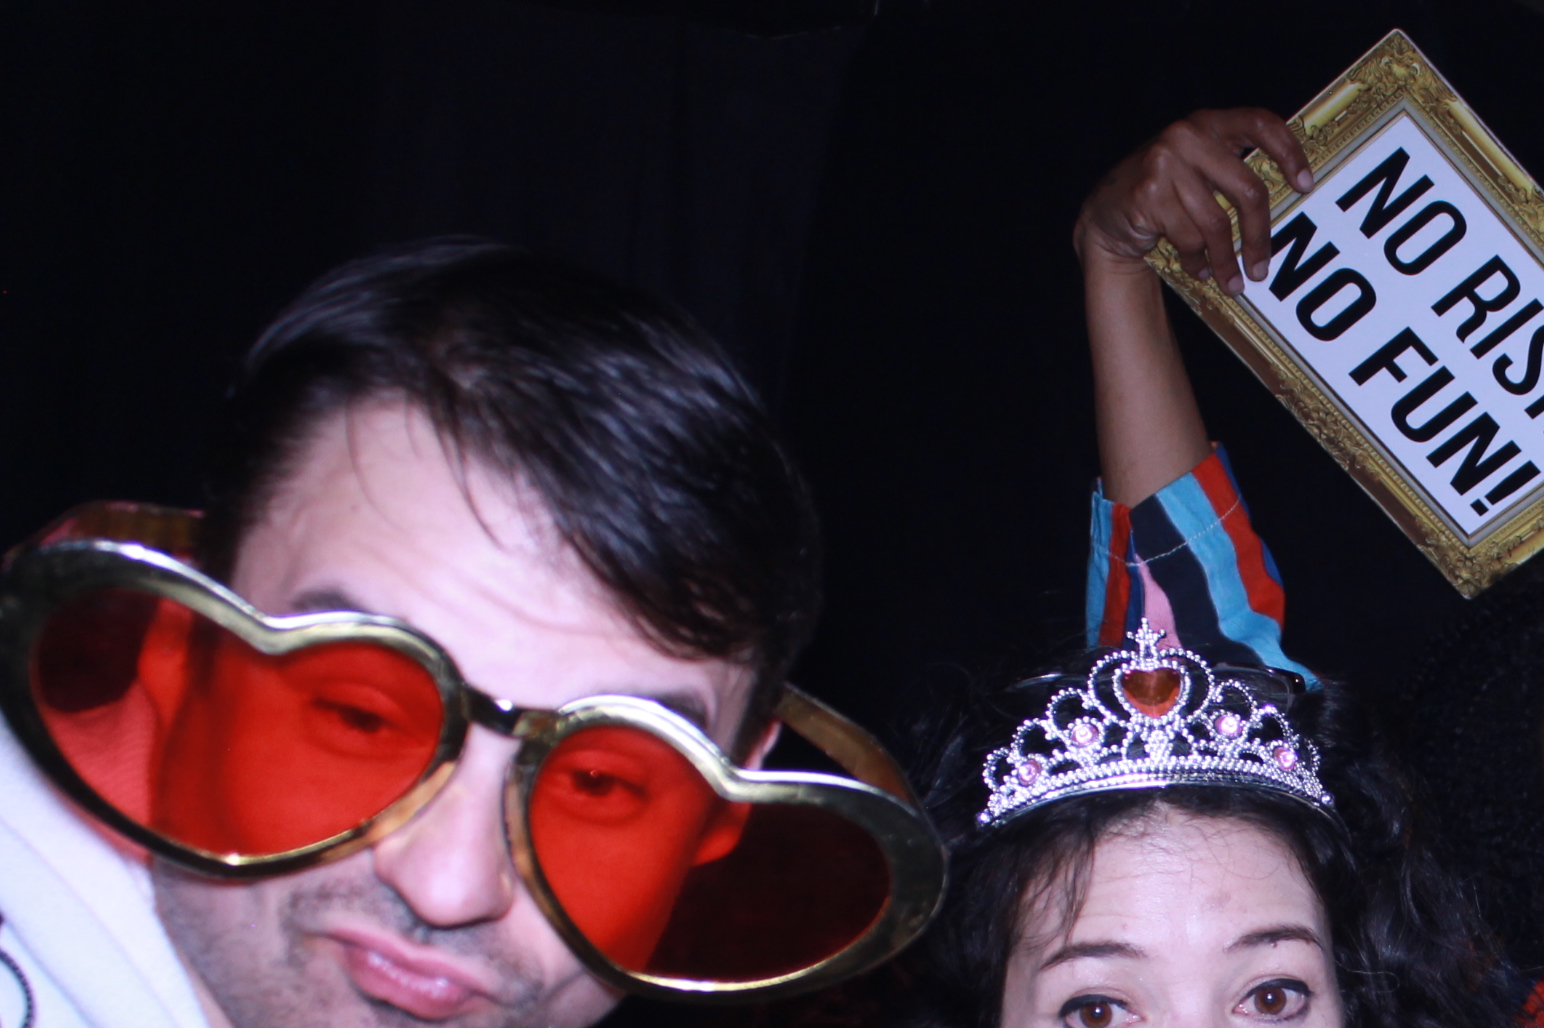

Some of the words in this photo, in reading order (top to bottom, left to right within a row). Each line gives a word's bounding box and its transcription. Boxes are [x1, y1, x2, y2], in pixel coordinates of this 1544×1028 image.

[1335, 147, 1467, 275] NO
[1269, 212, 1376, 341] NO
[1348, 327, 1541, 517] FUN!
